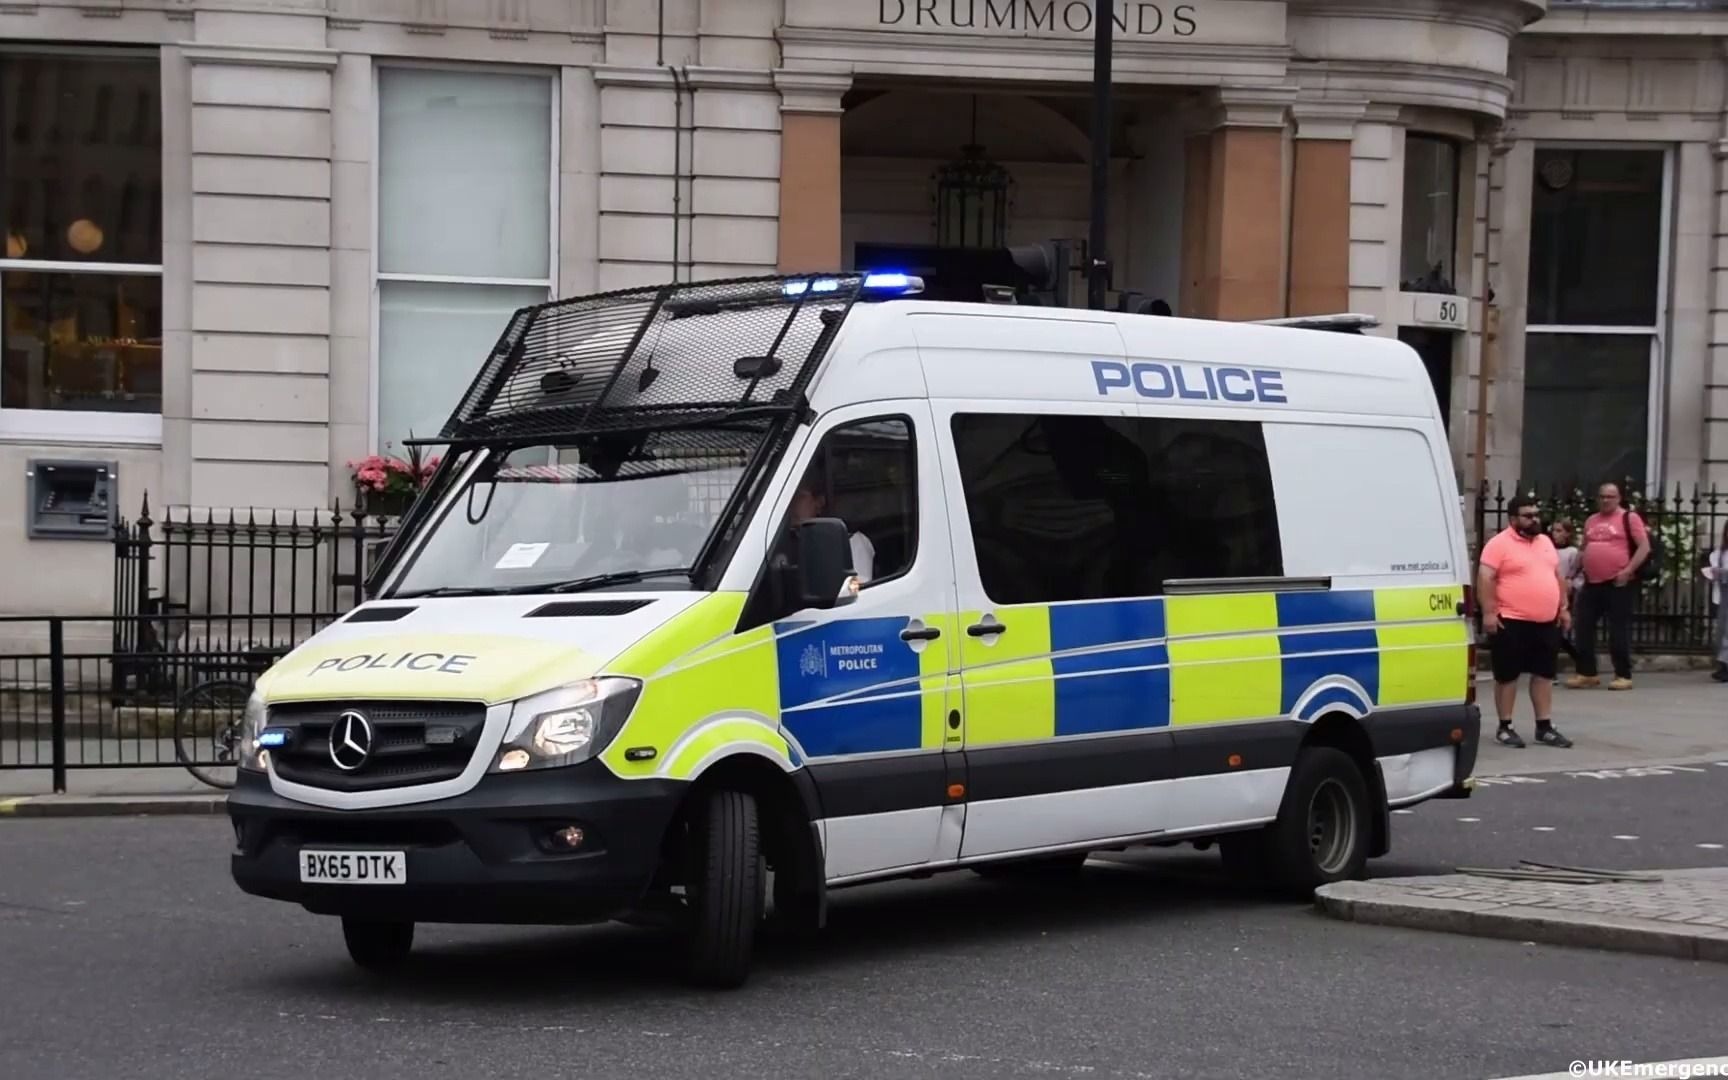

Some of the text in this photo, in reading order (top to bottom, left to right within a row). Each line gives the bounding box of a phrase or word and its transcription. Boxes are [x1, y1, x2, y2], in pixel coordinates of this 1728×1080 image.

[1440, 301, 1457, 322] 50
[1091, 360, 1288, 403] POLICE
[1390, 560, 1449, 574] www.met.police.uk
[1429, 593, 1452, 611] CHN
[830, 644, 884, 656] METROPOLITAN
[307, 652, 477, 677] POLICE
[838, 658, 878, 671] POLICE
[307, 854, 396, 879] BX65 DTK
